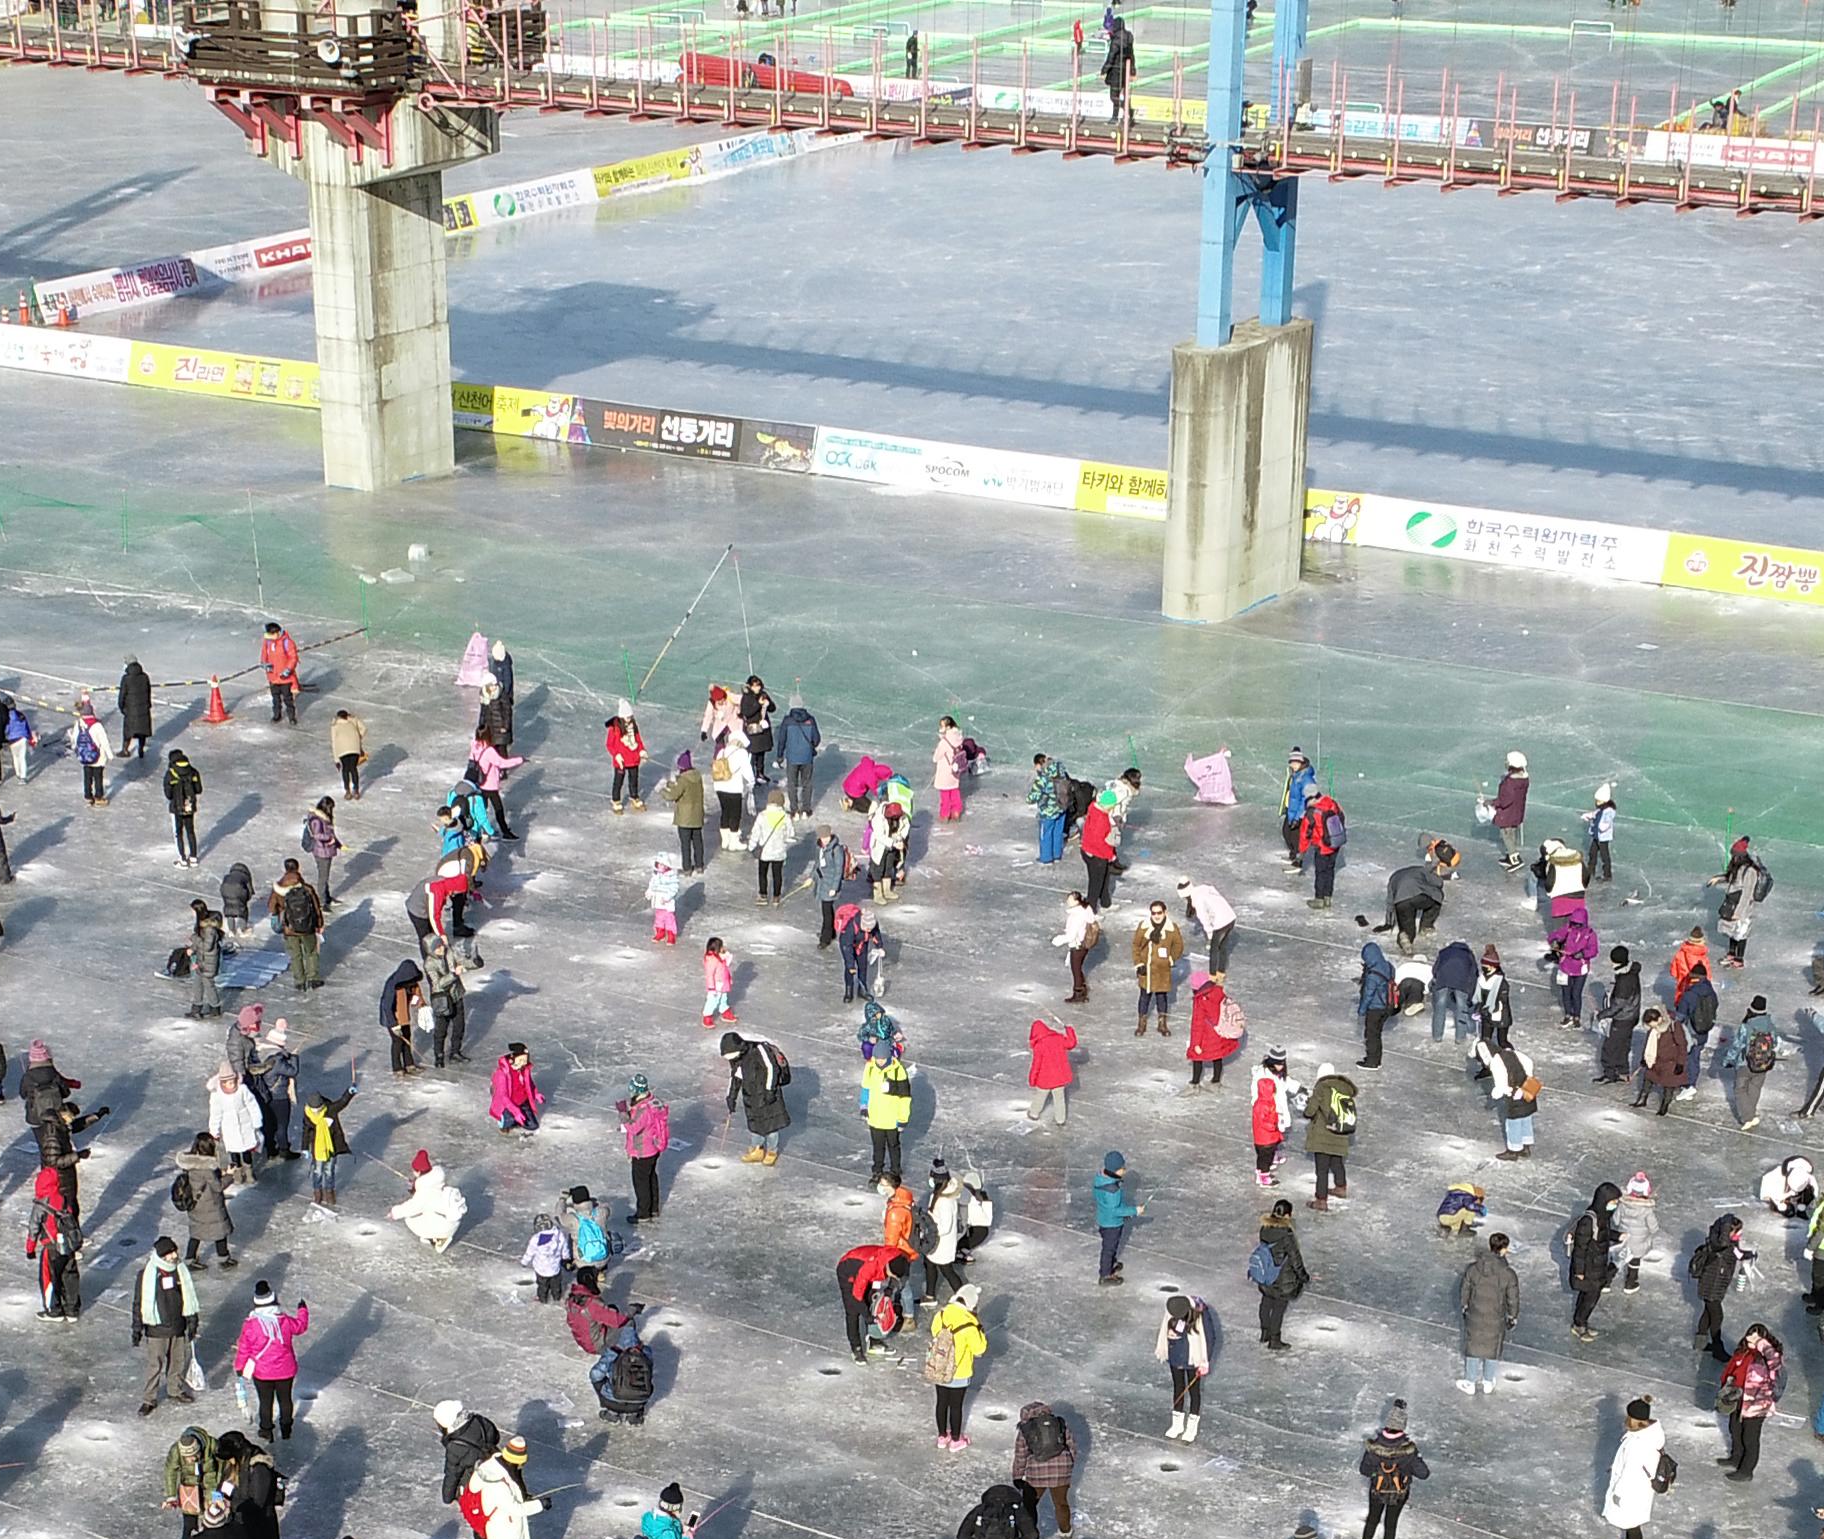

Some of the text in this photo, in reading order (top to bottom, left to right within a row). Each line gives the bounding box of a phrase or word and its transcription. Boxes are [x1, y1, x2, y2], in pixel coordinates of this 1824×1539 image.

[175, 357, 225, 382] 진라면
[458, 390, 520, 413] 산천어 축제
[603, 409, 657, 435] 빛의거리
[925, 462, 971, 479] SPOCOM
[1081, 470, 1125, 494] 타키와
[1737, 554, 1819, 593] 진짬뽕
